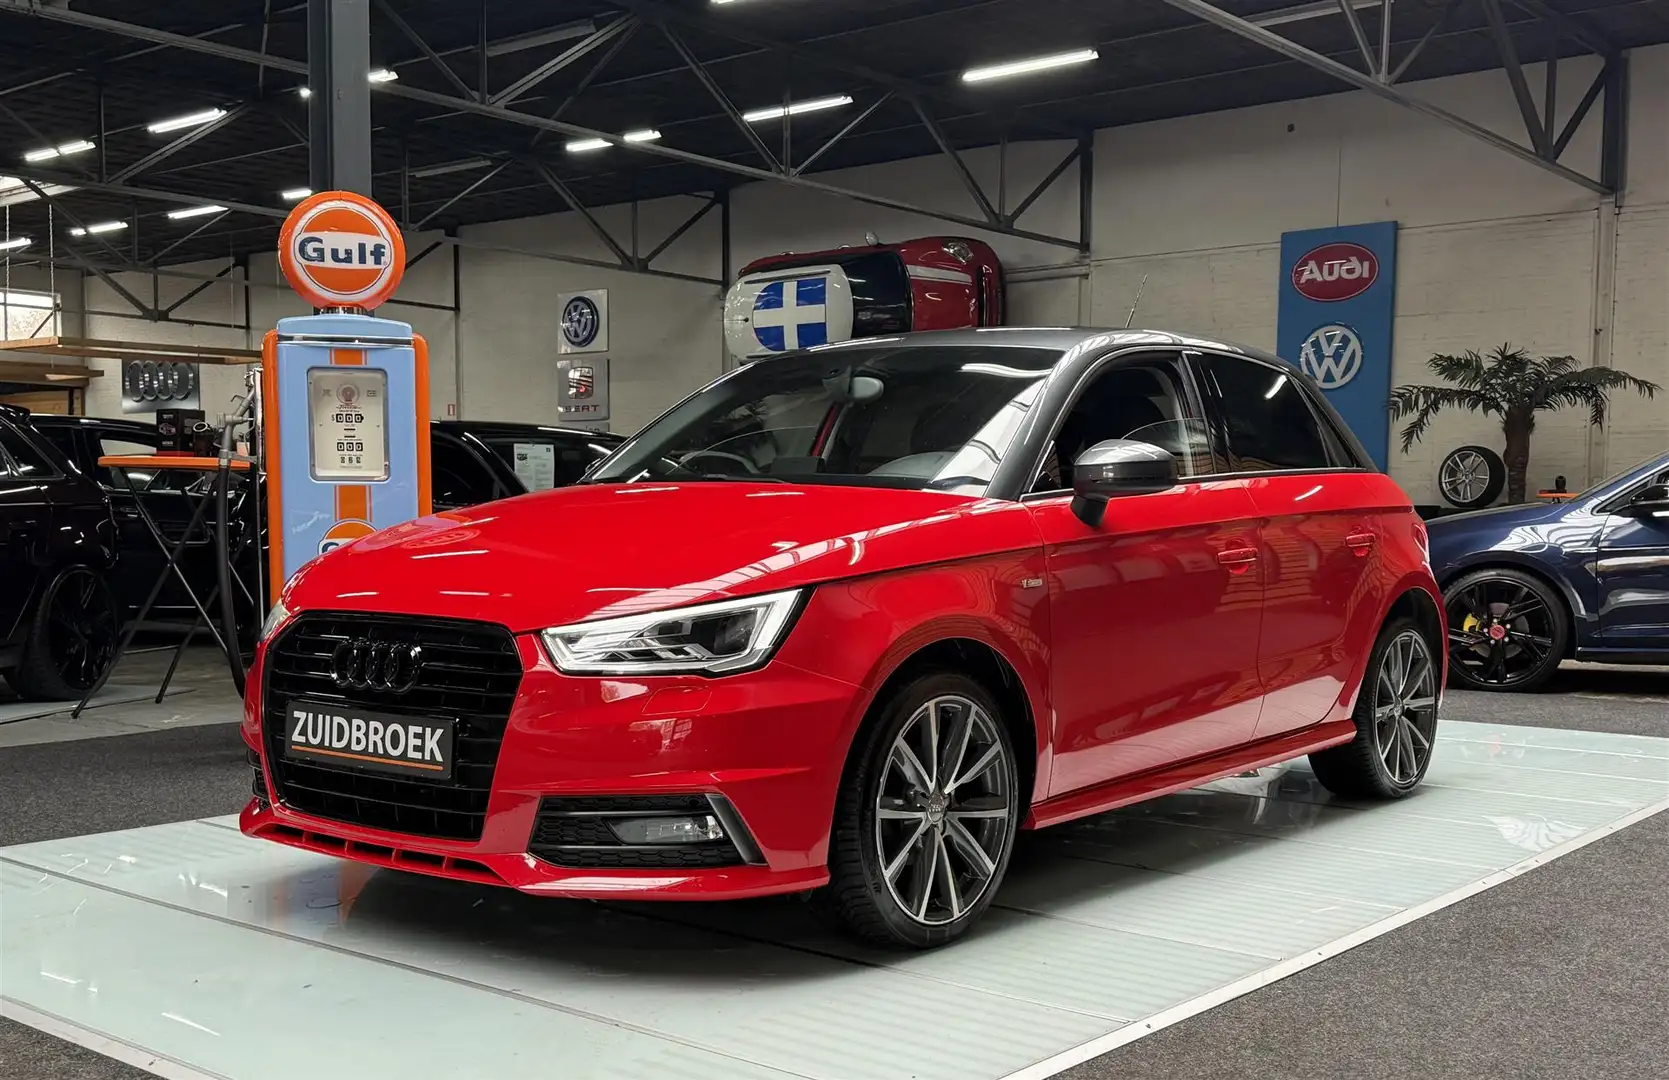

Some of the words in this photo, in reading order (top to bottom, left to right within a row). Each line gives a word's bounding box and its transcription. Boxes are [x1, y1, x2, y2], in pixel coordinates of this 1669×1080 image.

[298, 236, 386, 266] Gulf
[1300, 256, 1370, 283] Audi
[564, 404, 600, 413] SEAT
[291, 710, 445, 762] ZUIDBROEK
